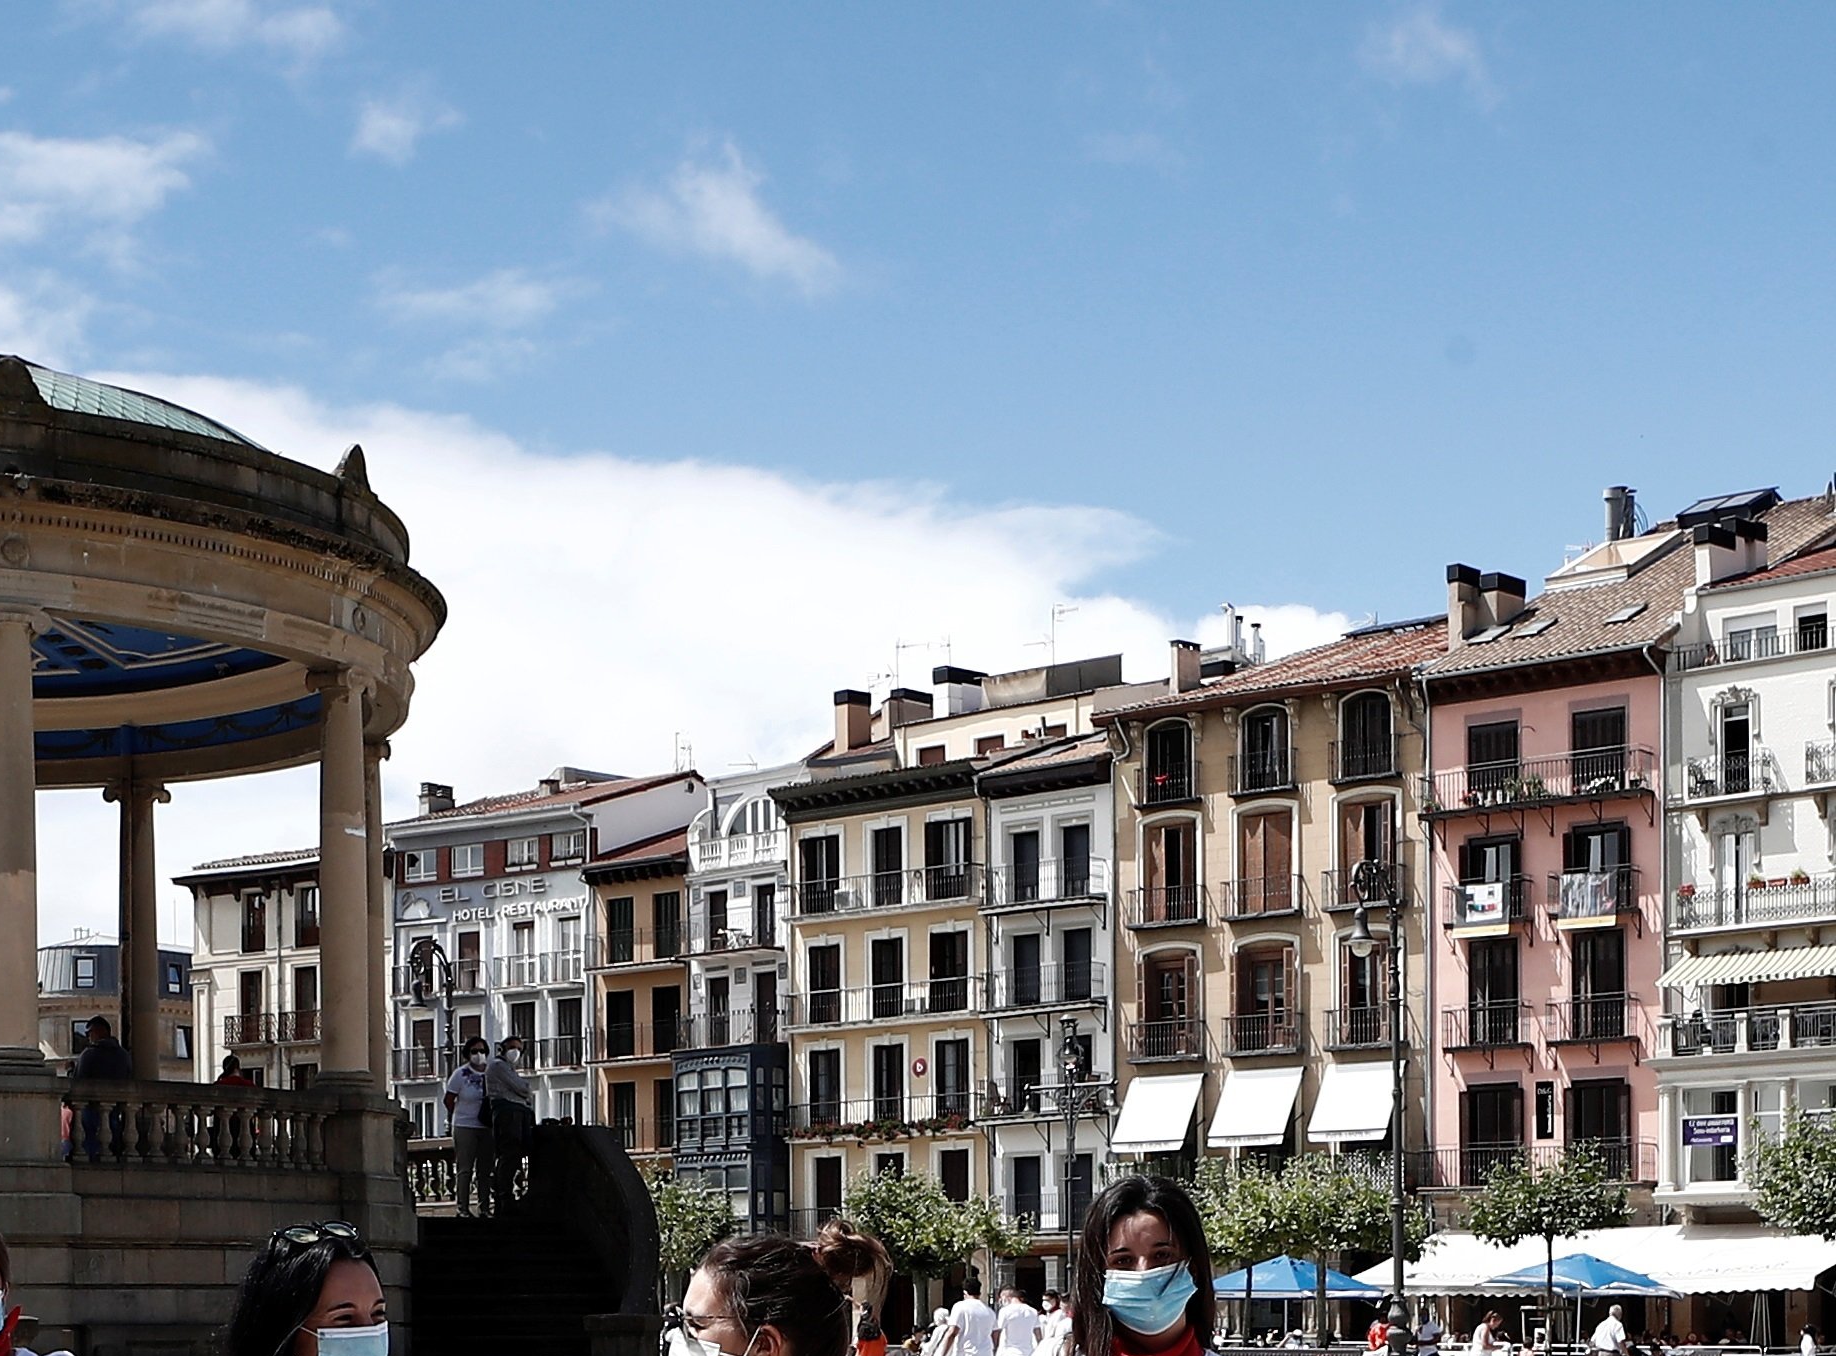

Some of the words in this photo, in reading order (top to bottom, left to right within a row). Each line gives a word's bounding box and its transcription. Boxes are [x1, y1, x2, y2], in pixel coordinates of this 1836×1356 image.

[439, 887, 470, 902] EL
[482, 877, 546, 898] CISNE
[452, 907, 494, 922] HOTEL
[501, 895, 586, 917] RESTAURANT
